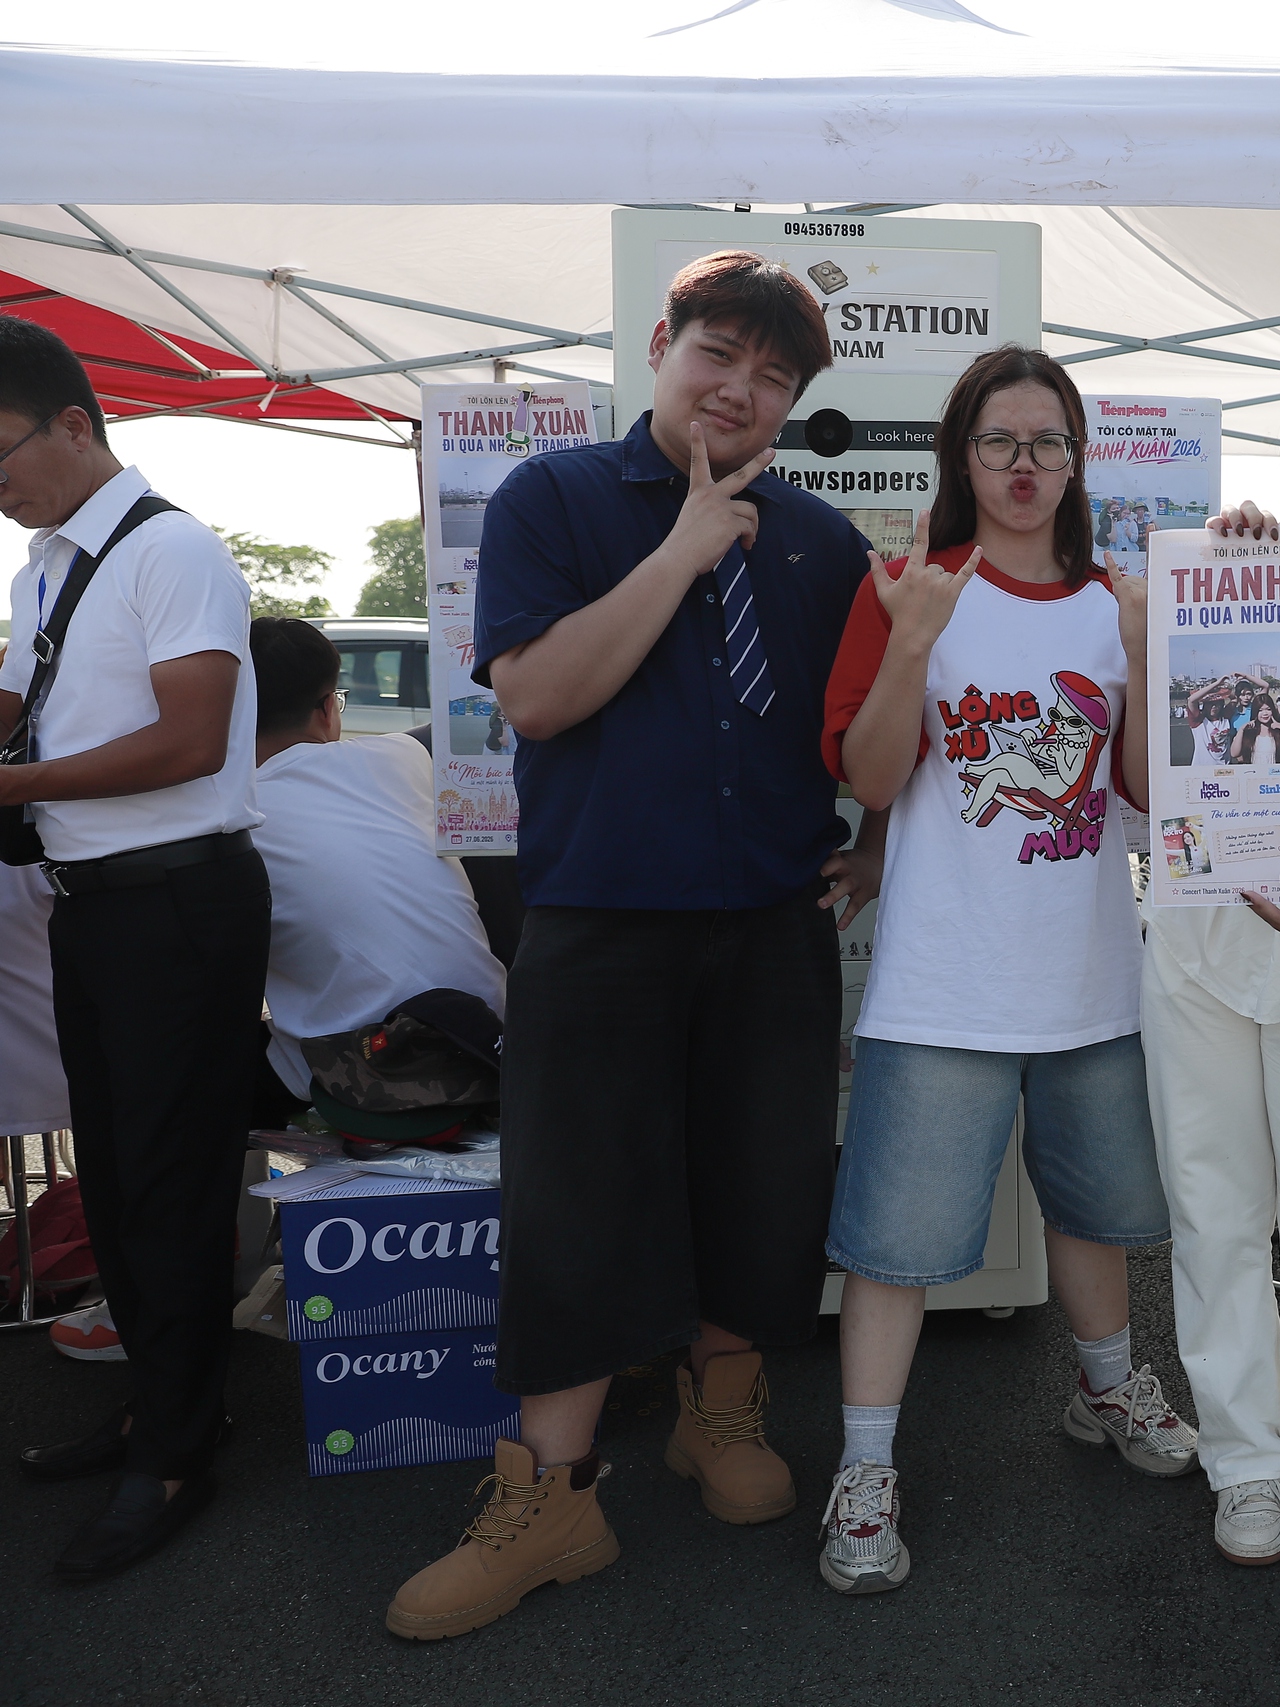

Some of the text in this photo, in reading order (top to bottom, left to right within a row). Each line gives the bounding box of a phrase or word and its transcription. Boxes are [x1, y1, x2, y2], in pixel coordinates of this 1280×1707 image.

[784, 222, 865, 237] 0945367898
[840, 302, 989, 336] STATION
[833, 339, 885, 359] NAM
[533, 407, 588, 436] XUÂN
[1097, 425, 1177, 438] TÔI CÓ MẶT TẠI
[442, 438, 455, 451] ĐI
[459, 438, 484, 453] QUA
[535, 438, 570, 452] TRANG
[867, 430, 935, 442] Look here
[1127, 437, 1171, 462] XUÂN
[1170, 438, 1201, 457] 2026
[769, 466, 929, 494] Newspapers
[1213, 546, 1228, 557] TÔI
[1252, 545, 1269, 555] LÊN
[1176, 608, 1193, 626] ĐI
[1199, 606, 1233, 628] QUA
[937, 683, 1041, 731] LÔNG
[1211, 809, 1223, 819] Tôi
[1241, 809, 1251, 818] có
[1253, 809, 1269, 818] một
[303, 1217, 500, 1275] Ocan
[316, 1347, 451, 1383] Ocany
